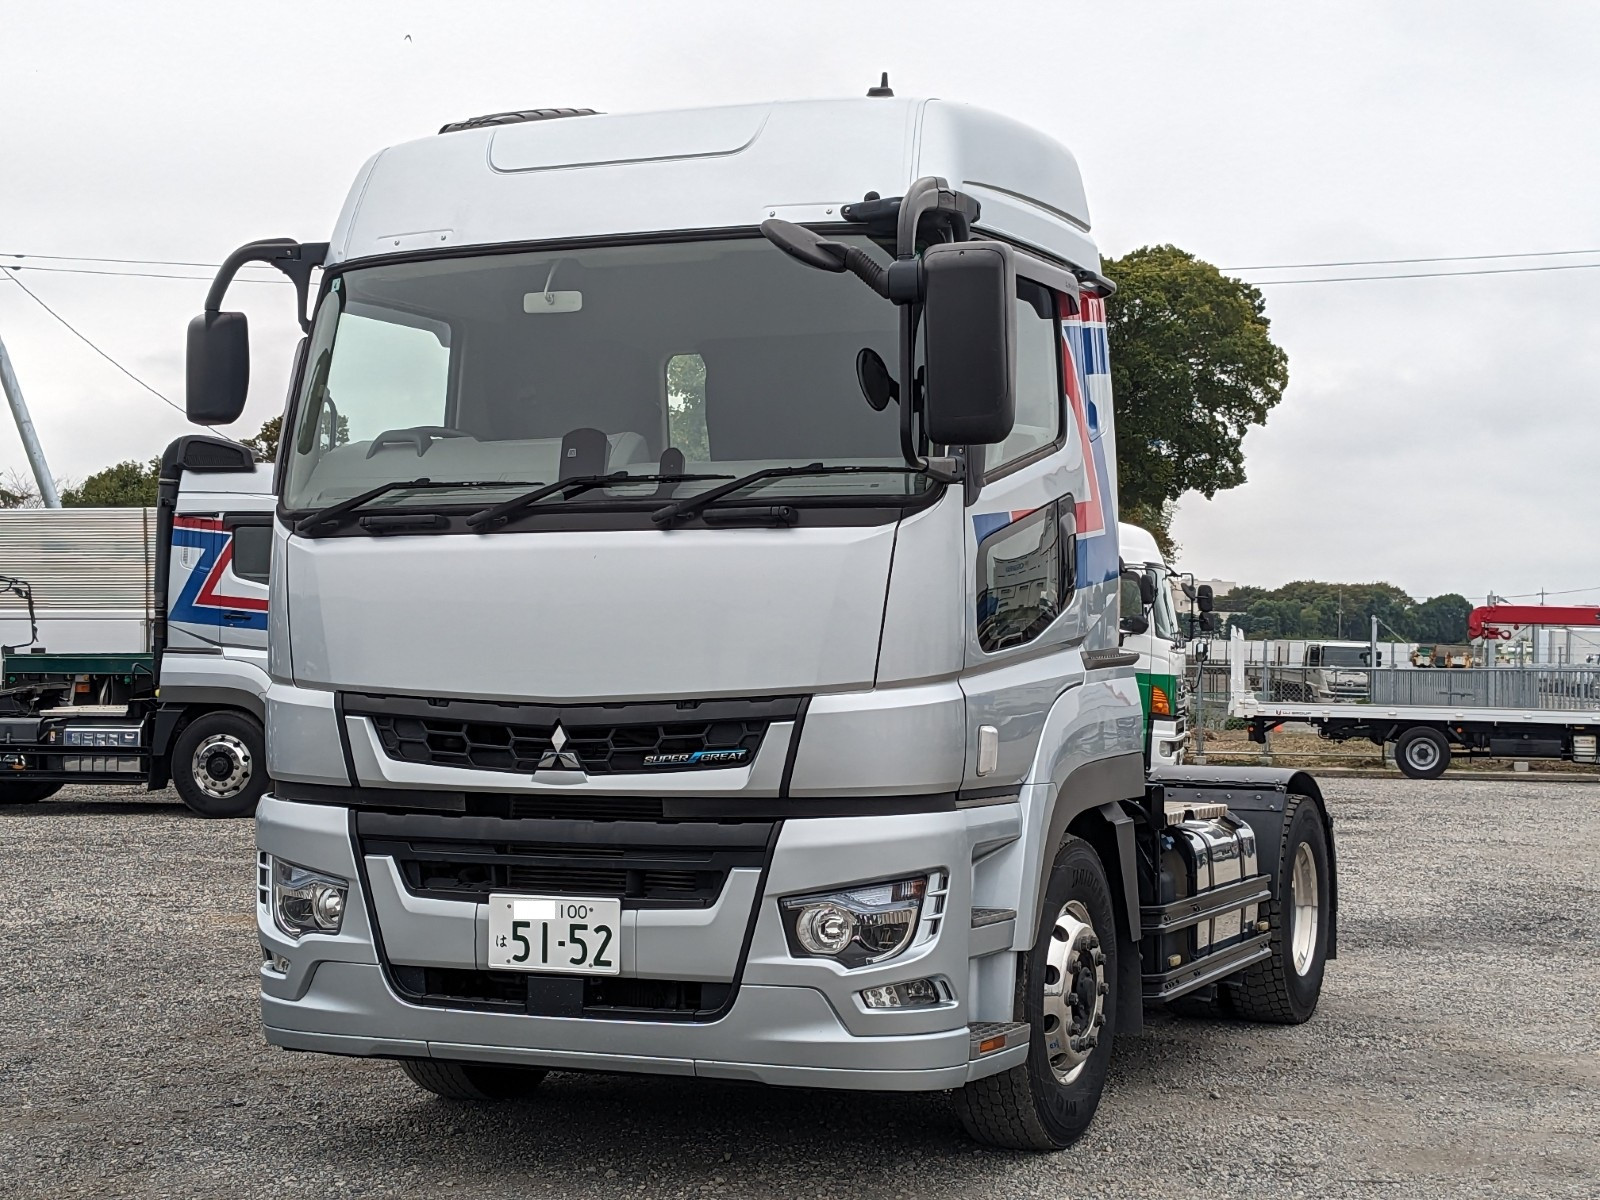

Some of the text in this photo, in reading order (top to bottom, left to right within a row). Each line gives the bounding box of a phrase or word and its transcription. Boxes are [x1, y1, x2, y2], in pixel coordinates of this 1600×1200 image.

[643, 751, 747, 764] SUPER GREAT
[560, 904, 588, 920] 100
[495, 920, 613, 967] は 51-52
